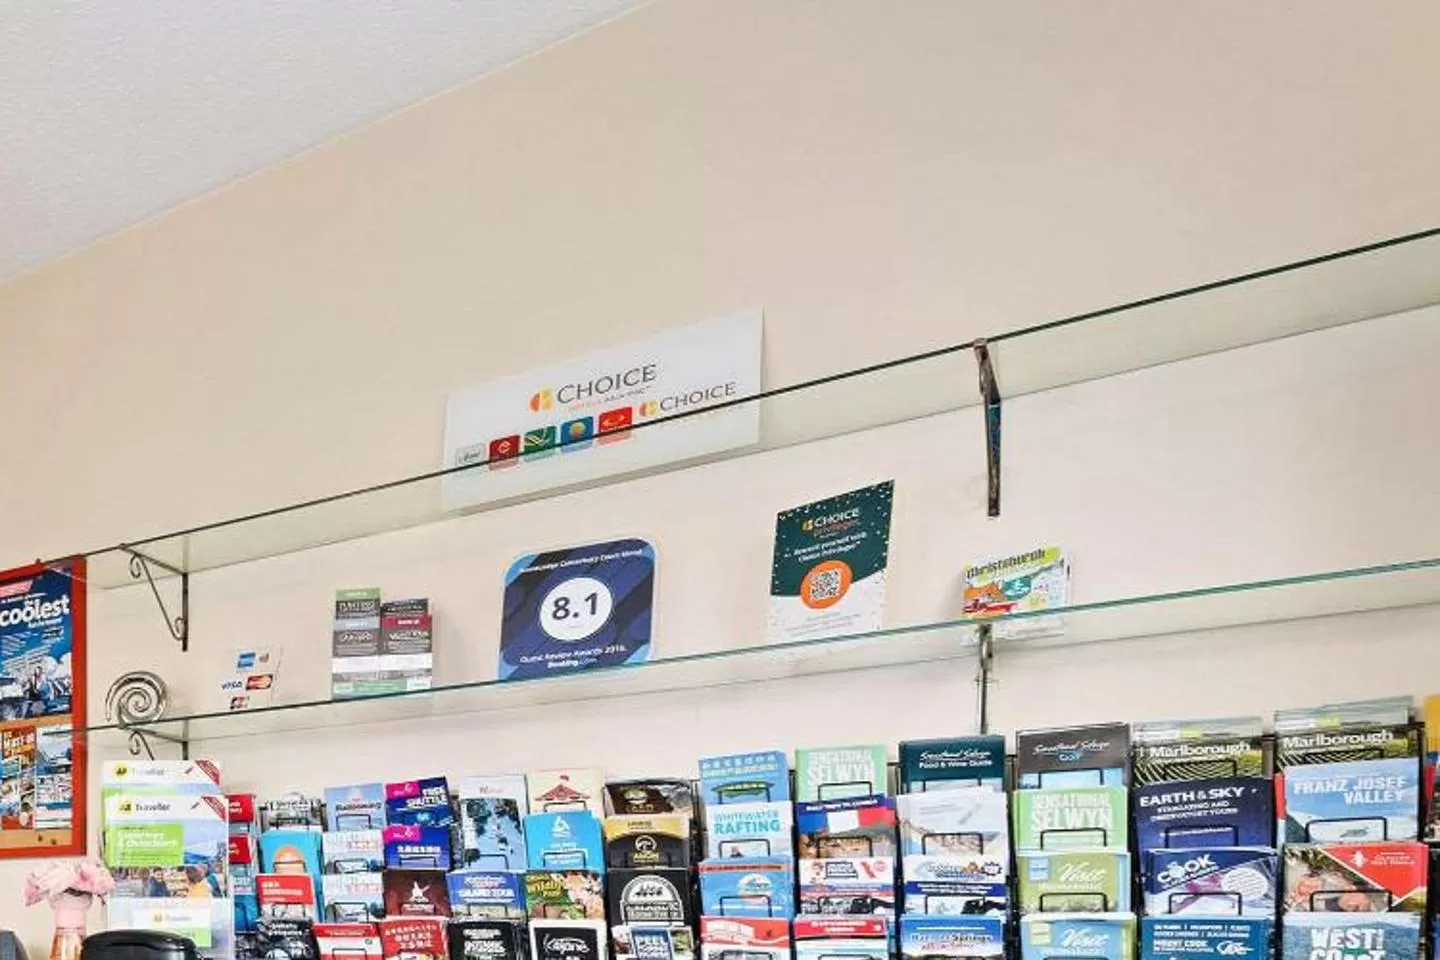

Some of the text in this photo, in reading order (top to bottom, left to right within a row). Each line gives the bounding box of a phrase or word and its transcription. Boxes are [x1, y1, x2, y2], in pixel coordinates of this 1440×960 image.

[556, 363, 657, 405] CHOICE
[659, 381, 738, 413] CHOICE
[814, 507, 861, 528] CHOICE
[552, 592, 599, 621] 8.1
[1283, 728, 1394, 749] Marlborough
[1149, 741, 1251, 758] Marlborough
[807, 762, 876, 784] SELWYN
[919, 760, 939, 769] Food
[948, 760, 967, 768] Wine
[968, 758, 993, 768] Guide
[1293, 775, 1410, 795] FRANZ JOSEF
[1140, 786, 1246, 808] EARTH & SKY
[1211, 800, 1231, 809] AND
[1343, 789, 1406, 806] VALLEY
[135, 803, 171, 813] Traveller
[714, 810, 780, 824] WHITEWATER
[1032, 806, 1112, 830] SELWYN
[714, 819, 781, 835] RAFTING
